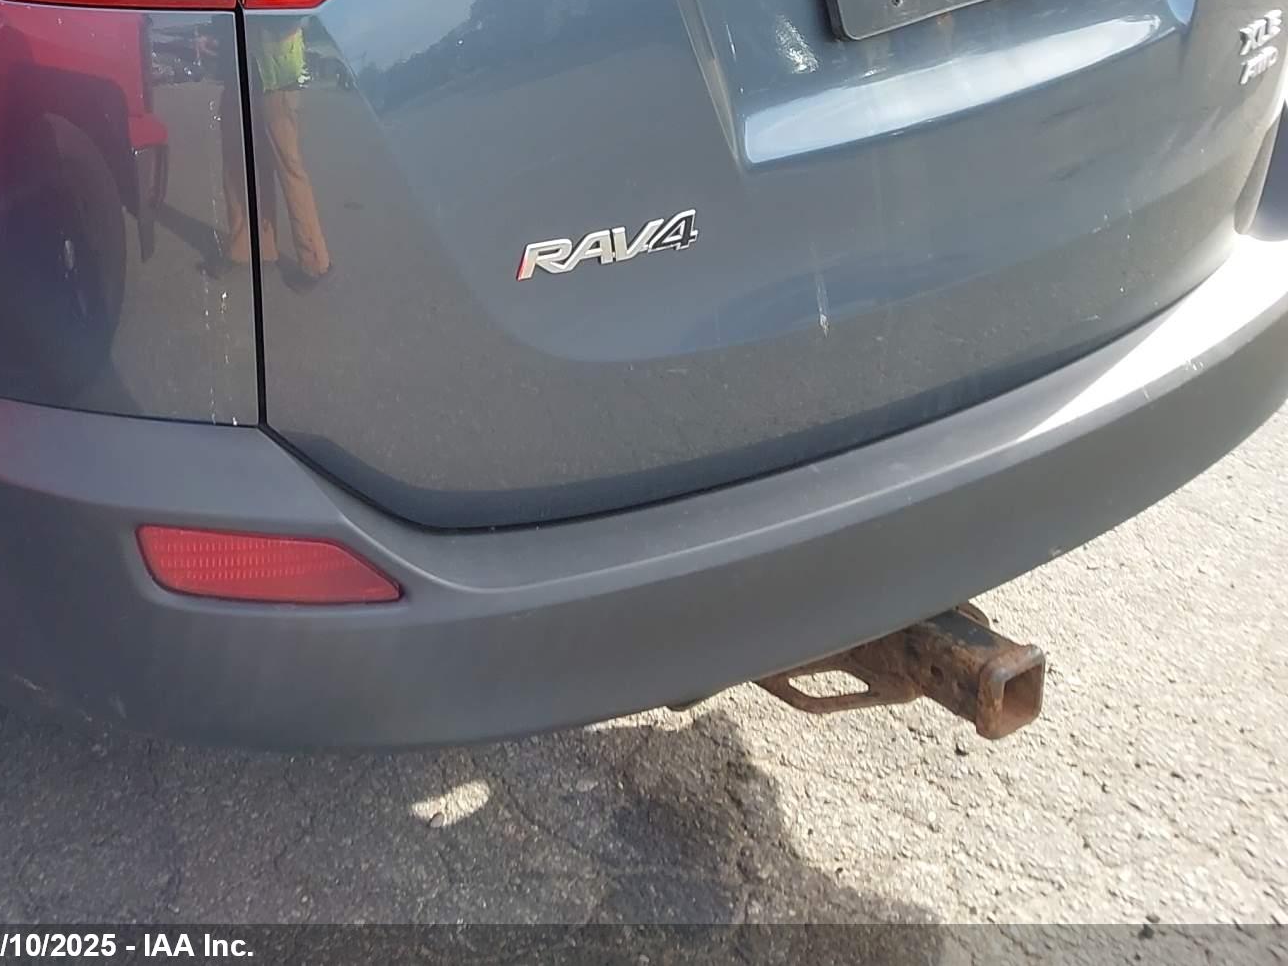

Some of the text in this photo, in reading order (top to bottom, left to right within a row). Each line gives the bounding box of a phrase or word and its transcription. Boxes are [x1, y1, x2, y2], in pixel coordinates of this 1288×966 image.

[1239, 9, 1282, 55] XLE
[1240, 45, 1279, 86] AWD
[516, 208, 699, 281] RAV4
